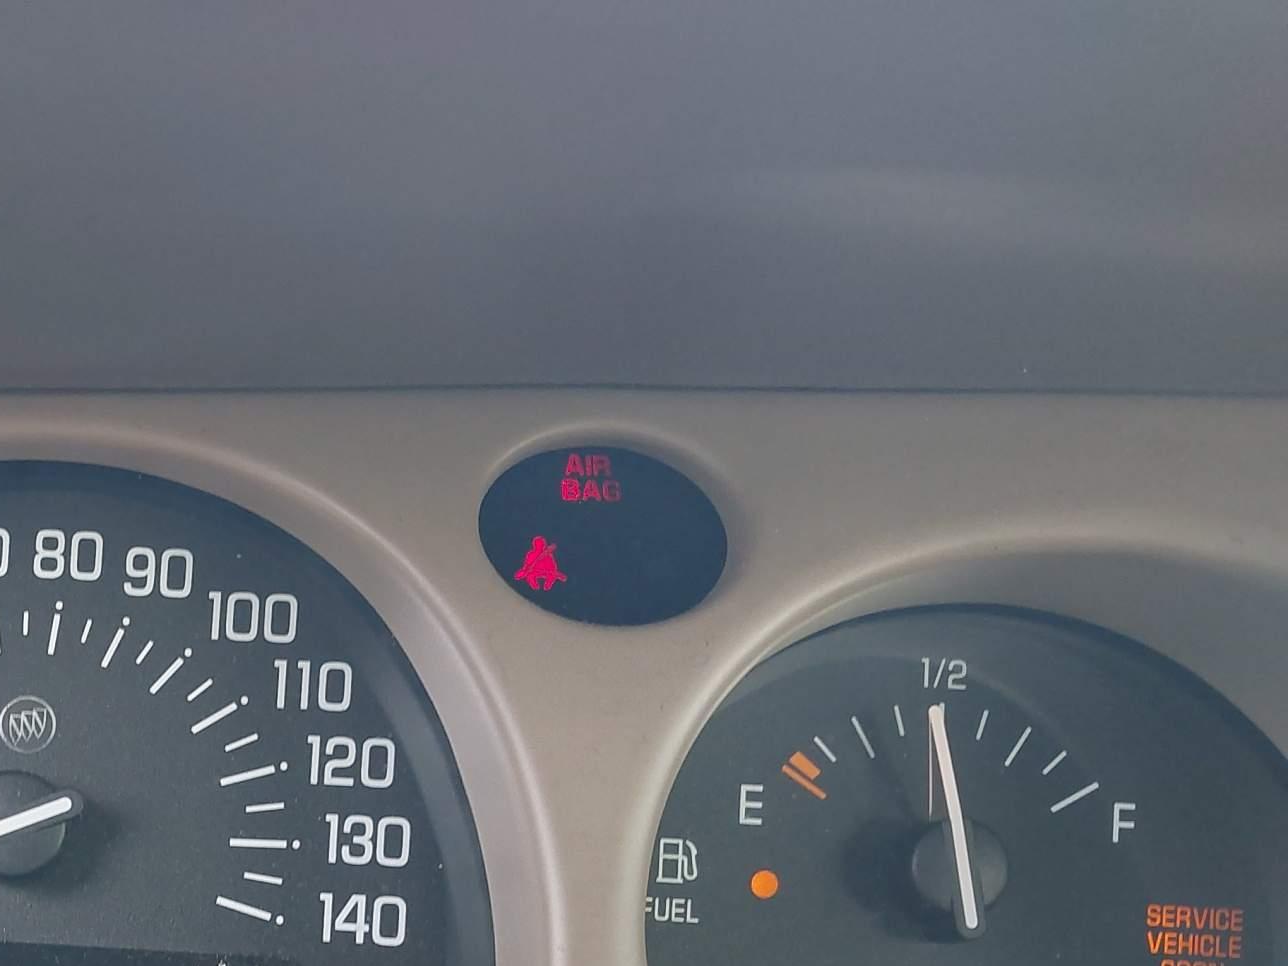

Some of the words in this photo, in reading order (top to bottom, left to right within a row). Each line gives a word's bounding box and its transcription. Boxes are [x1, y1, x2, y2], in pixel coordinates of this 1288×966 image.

[565, 454, 610, 475] AIR
[561, 479, 619, 501] BAG
[33, 529, 104, 582] 80
[123, 546, 194, 599] 90
[208, 591, 298, 644] 100
[273, 659, 352, 712] 110
[921, 658, 967, 690] 1/2
[307, 735, 396, 788] 120
[739, 784, 764, 825] E
[1112, 803, 1136, 843] F
[325, 813, 411, 868] 130
[319, 892, 407, 947] 140
[1146, 904, 1244, 931] SERVICE
[1146, 931, 1242, 959] VEHICLE
